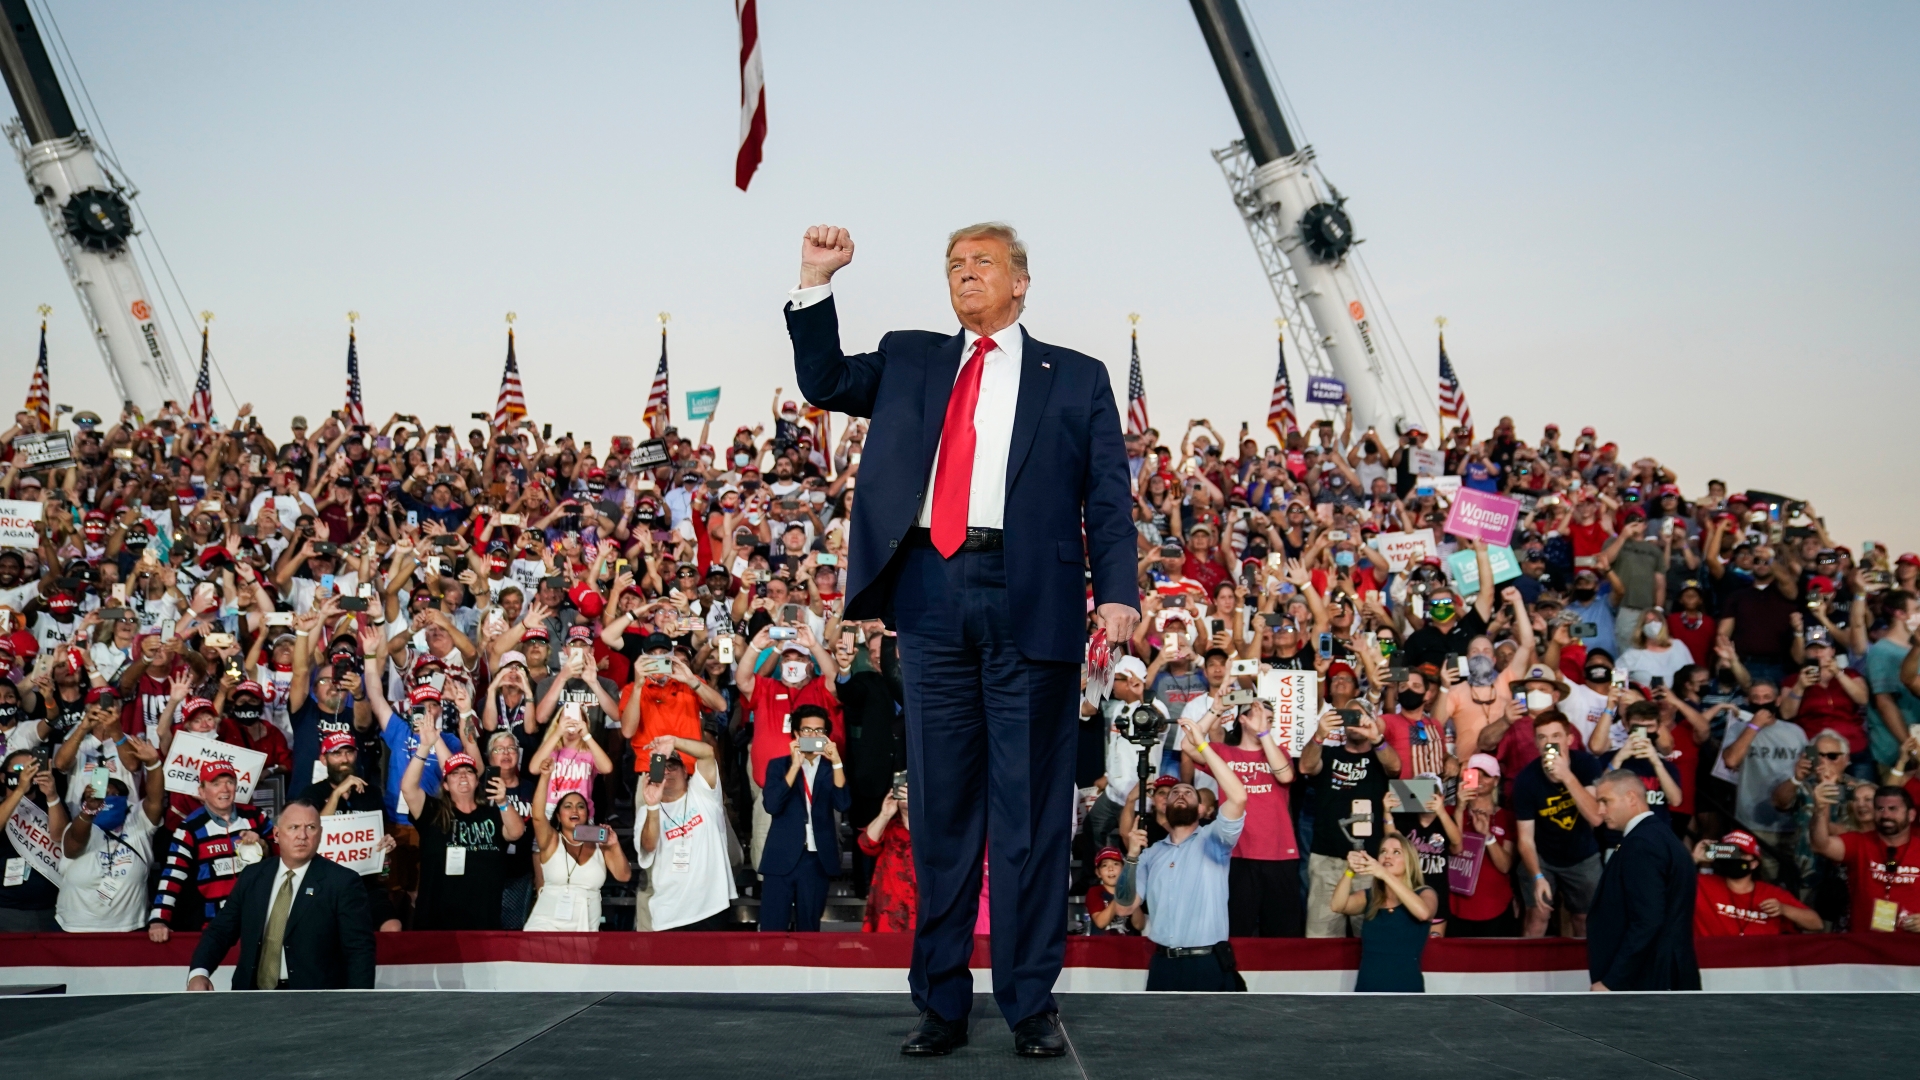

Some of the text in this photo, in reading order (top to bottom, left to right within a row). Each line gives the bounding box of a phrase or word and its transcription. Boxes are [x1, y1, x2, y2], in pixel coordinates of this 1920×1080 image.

[141, 323, 161, 358] Sims
[1357, 320, 1375, 354] Sims
[1312, 382, 1343, 393] 4 MORE
[1460, 500, 1510, 527] Women
[1462, 516, 1503, 533] FOR TRUMP
[3, 528, 35, 539] AGAIN
[1459, 552, 1506, 574] Laos
[50, 600, 78, 608] MAGA
[47, 630, 67, 641] BLA
[418, 676, 432, 685] MA
[1280, 675, 1292, 751] AMERICA
[1296, 675, 1305, 752] GREAT AGAIN
[200, 748, 236, 764] MAKE
[1748, 747, 1798, 760] ARMY
[167, 769, 200, 784] GREA
[553, 760, 592, 780] RUMP
[1244, 784, 1273, 794] TUCKY
[33, 815, 51, 832] MA
[451, 818, 496, 845] TRUMP
[9, 822, 35, 852] GREAT
[11, 813, 62, 859] AMERIC
[327, 829, 375, 846] MORE
[207, 843, 230, 854] TRU
[1709, 844, 1736, 853] Trump
[35, 851, 61, 875] AGAI
[1420, 855, 1447, 876] UMP
[1448, 855, 1474, 878] Wom
[1870, 861, 1920, 874] TRMP
[1716, 903, 1769, 920] TRUMP
